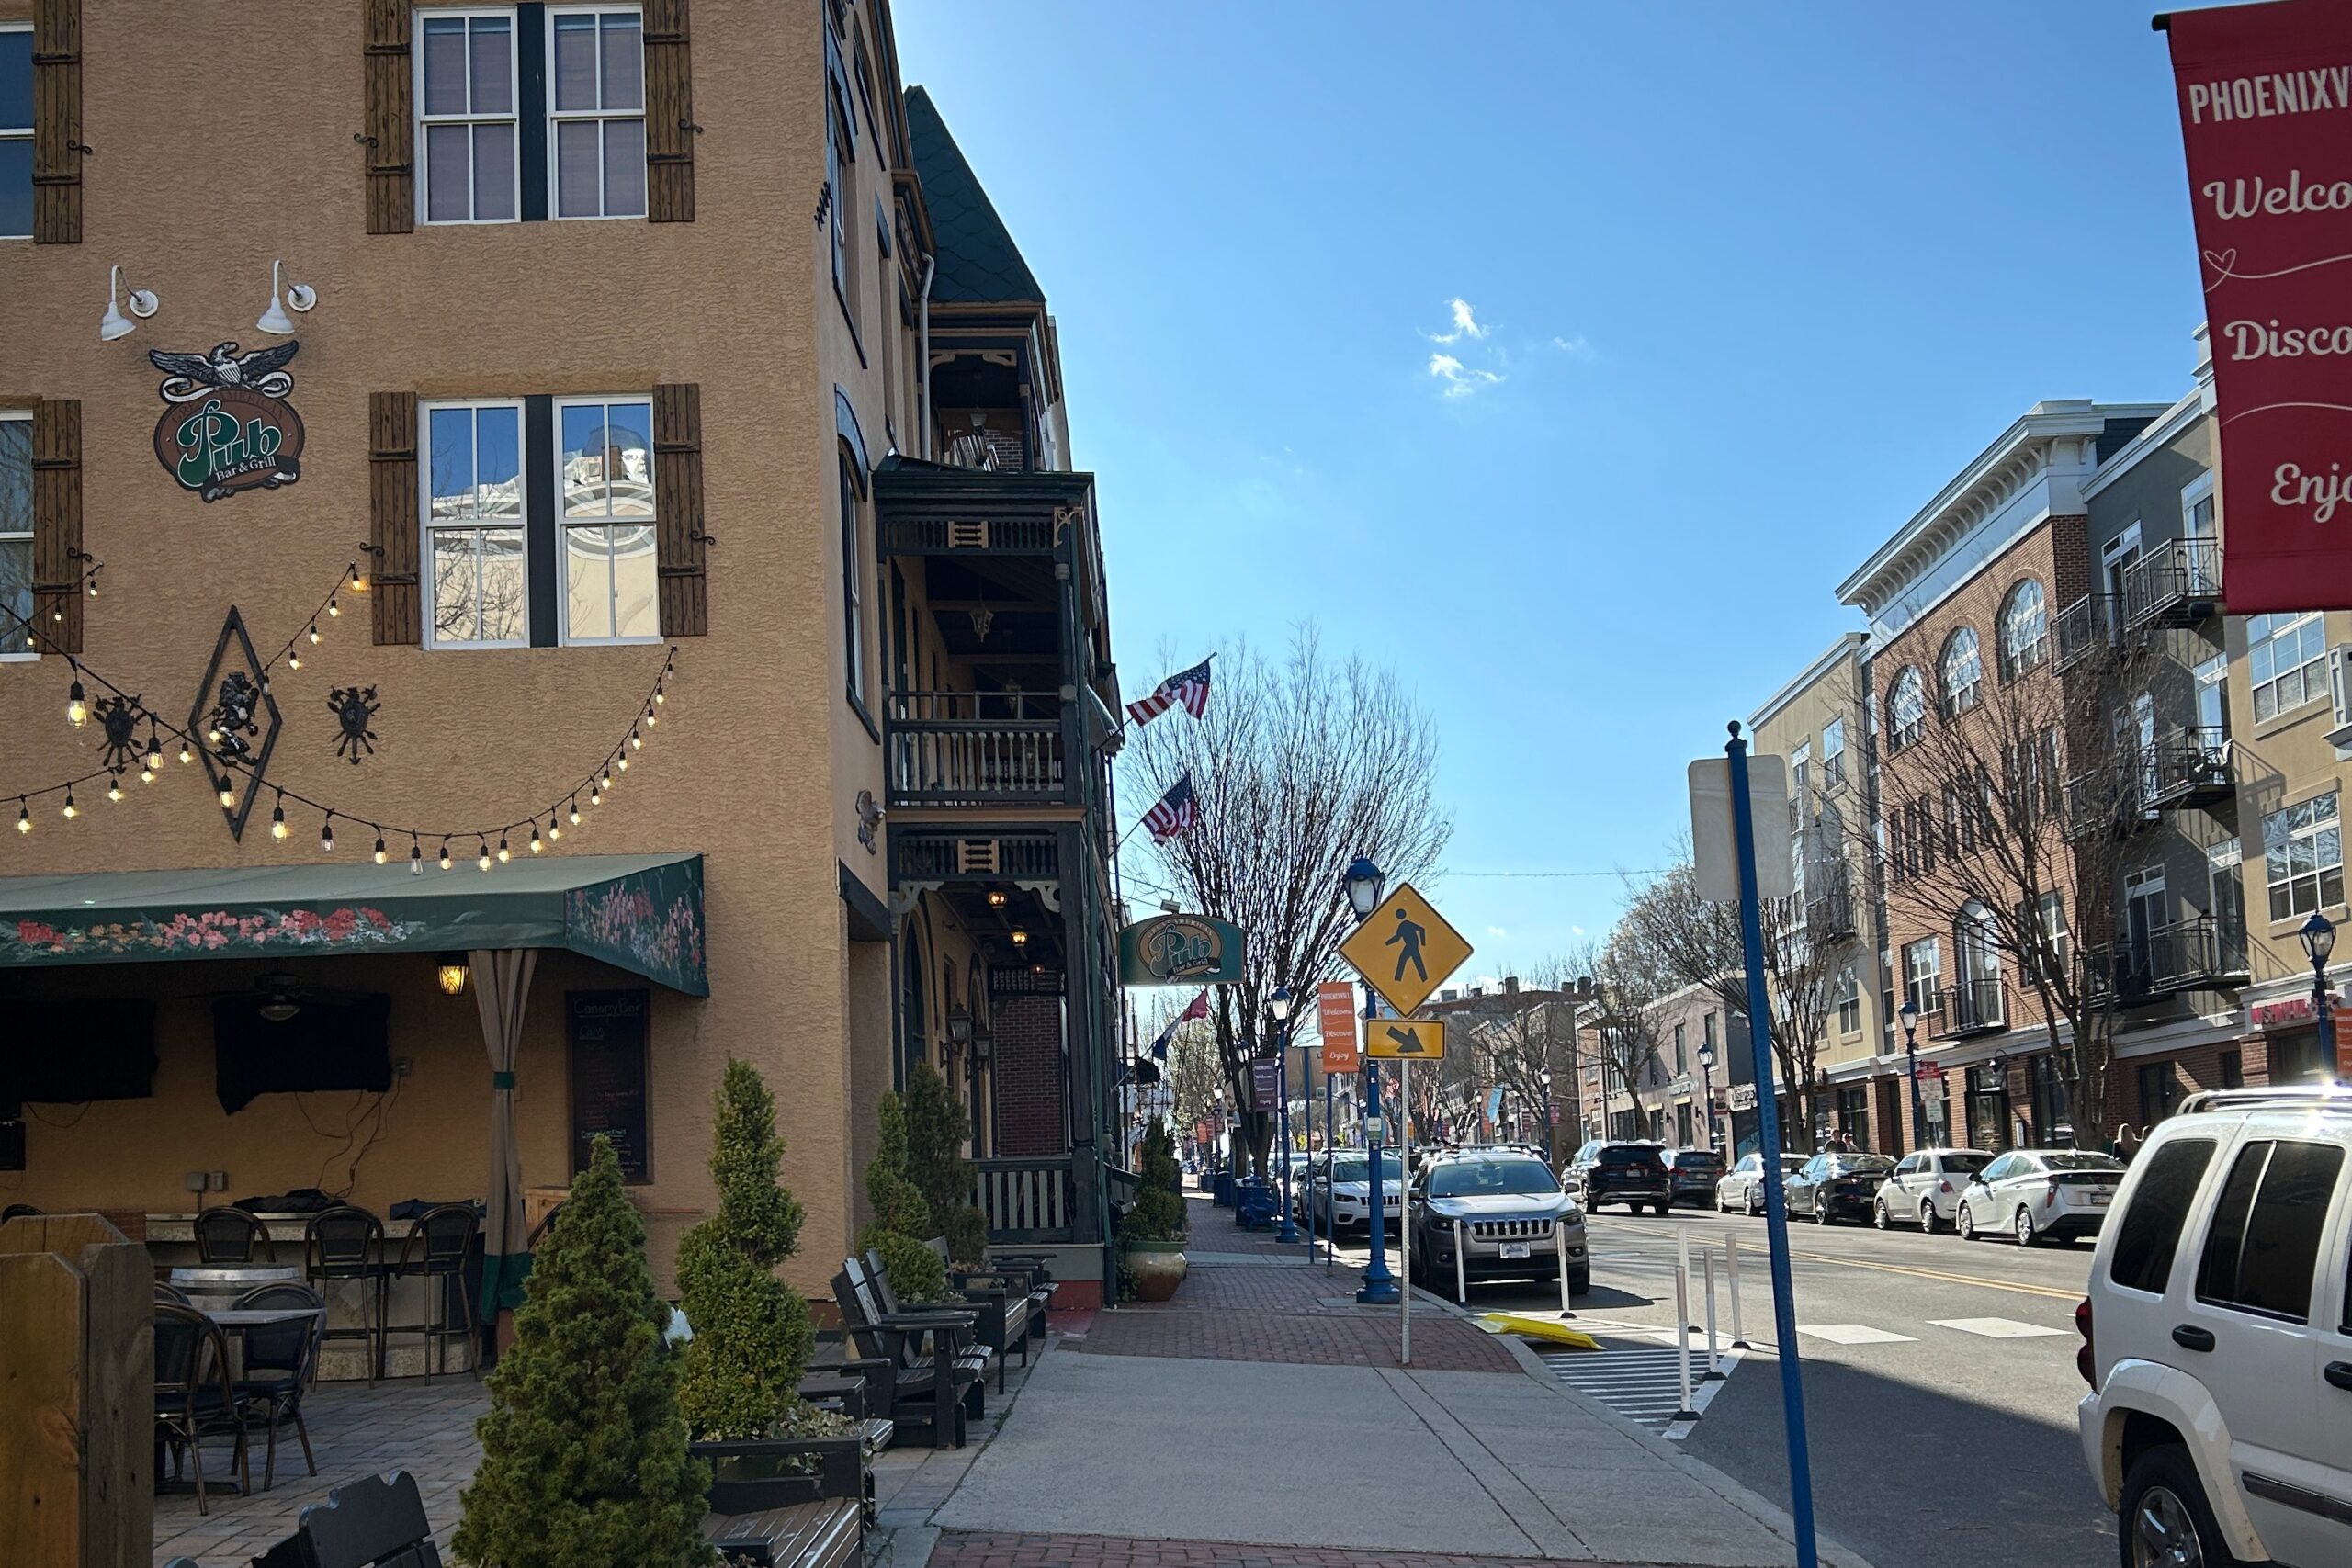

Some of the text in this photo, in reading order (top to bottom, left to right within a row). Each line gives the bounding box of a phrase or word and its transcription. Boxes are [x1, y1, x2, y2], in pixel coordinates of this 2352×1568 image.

[176, 399, 282, 487] Pub
[215, 457, 277, 482] Bar & Grill
[1148, 923, 1212, 977] Pub
[1172, 963, 1186, 974] Bar
[1193, 958, 1208, 967] Grill
[618, 998, 642, 1015] Bar
[1323, 1008, 1353, 1016] Welcome
[1329, 1052, 1349, 1061] Enjoy
